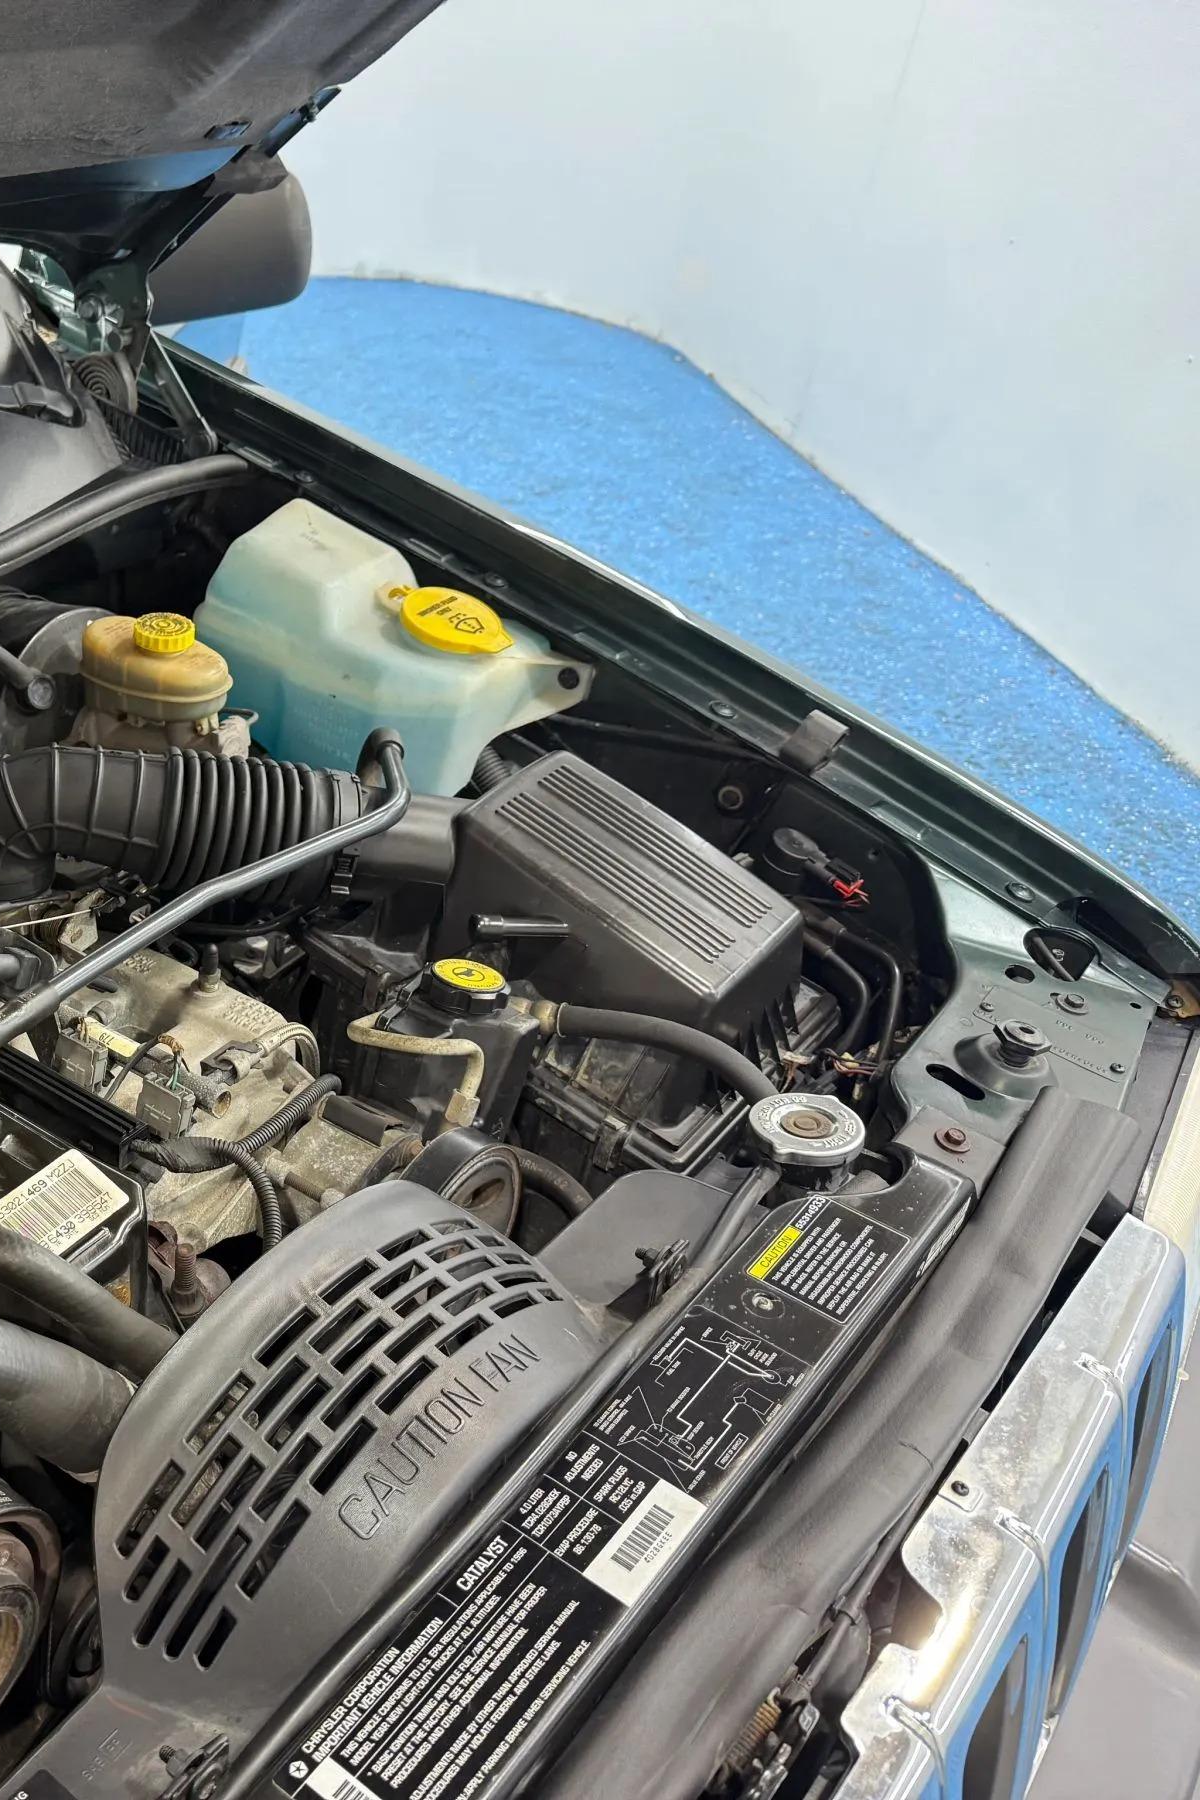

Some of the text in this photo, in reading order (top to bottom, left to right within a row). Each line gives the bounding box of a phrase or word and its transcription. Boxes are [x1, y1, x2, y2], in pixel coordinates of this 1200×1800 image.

[45, 1157, 75, 1182] M2ZJ
[73, 1191, 113, 1224] 399547
[758, 1195, 826, 1268] CAUTION 55314933
[771, 1271, 783, 1281] THIS
[779, 1256, 796, 1273] VEHICLE
[795, 1235, 814, 1254] EQUIPPED
[810, 1226, 822, 1237] WITH
[781, 1217, 842, 1286] SUPPLEMENTAL DRIVER AND PASSENGER
[790, 1282, 799, 1291] AIR
[804, 1259, 819, 1273] REFER
[819, 1246, 830, 1256] THE
[825, 1232, 842, 1249] SERVICE
[798, 1240, 848, 1296] MANUAL BEFORE SERVICING OR
[339, 1333, 541, 1540] CAUTION FAN
[564, 1443, 600, 1482] ADJUSTMENTS
[565, 1451, 578, 1462] NO
[581, 1458, 604, 1481] NEEDED
[593, 1465, 628, 1502] SPARK PLUGS
[608, 1477, 634, 1503] RC12LYC
[519, 1488, 545, 1515] 4.0 LITER
[553, 1508, 599, 1557] EVAP PROCEDURE
[572, 1523, 602, 1555] 86.130-78
[644, 1531, 673, 1564] 4028GKEE
[456, 1535, 508, 1591] CATALYST
[340, 1546, 528, 1758] THIS VEHICLE CONFORMS TO U.S. EPA REGULATIONS APPLICABLE TO 1996
[349, 1594, 501, 1766] MODEL YEAR NEW LIGHT-DUTY TRUCKS AT ALL ALTITUDES.
[371, 1582, 536, 1773] BASIC IGNITION TIMING AND IDLE FUEL/AIR MIXTURE HAVE BEEN
[449, 1730, 472, 1754] MADE
[466, 1720, 479, 1734] BY
[475, 1699, 497, 1723] OTHER
[492, 1681, 512, 1701] THAN
[508, 1648, 539, 1684] APPROVED
[534, 1624, 559, 1651] SERVICE
[554, 1600, 580, 1627] MANUAL
[302, 1647, 400, 1754] CHRYSLER CORPORATION
[312, 1617, 443, 1762] IMPORTANT VEHICLE INFORMATION
[381, 1586, 548, 1781] PRESET AT THE FACTORY. SEE THE SERVICE MANUAL FOR PROPER
[390, 1627, 528, 1788] PROCEDURES AND OTHER ADDITIONAL INFORMATION.
[455, 1746, 473, 1767] MAY
[468, 1720, 495, 1750] VIOLATE
[490, 1694, 518, 1724] FEDERAL
[513, 1678, 530, 1696] AND
[524, 1658, 546, 1681] STATE
[540, 1640, 561, 1661] LAWS.
[480, 1741, 510, 1774] PARKING
[504, 1718, 528, 1744] BRAKE
[522, 1697, 545, 1721] WHEN
[539, 1665, 570, 1700] SERVICING
[565, 1640, 591, 1667] VEHICLE.
